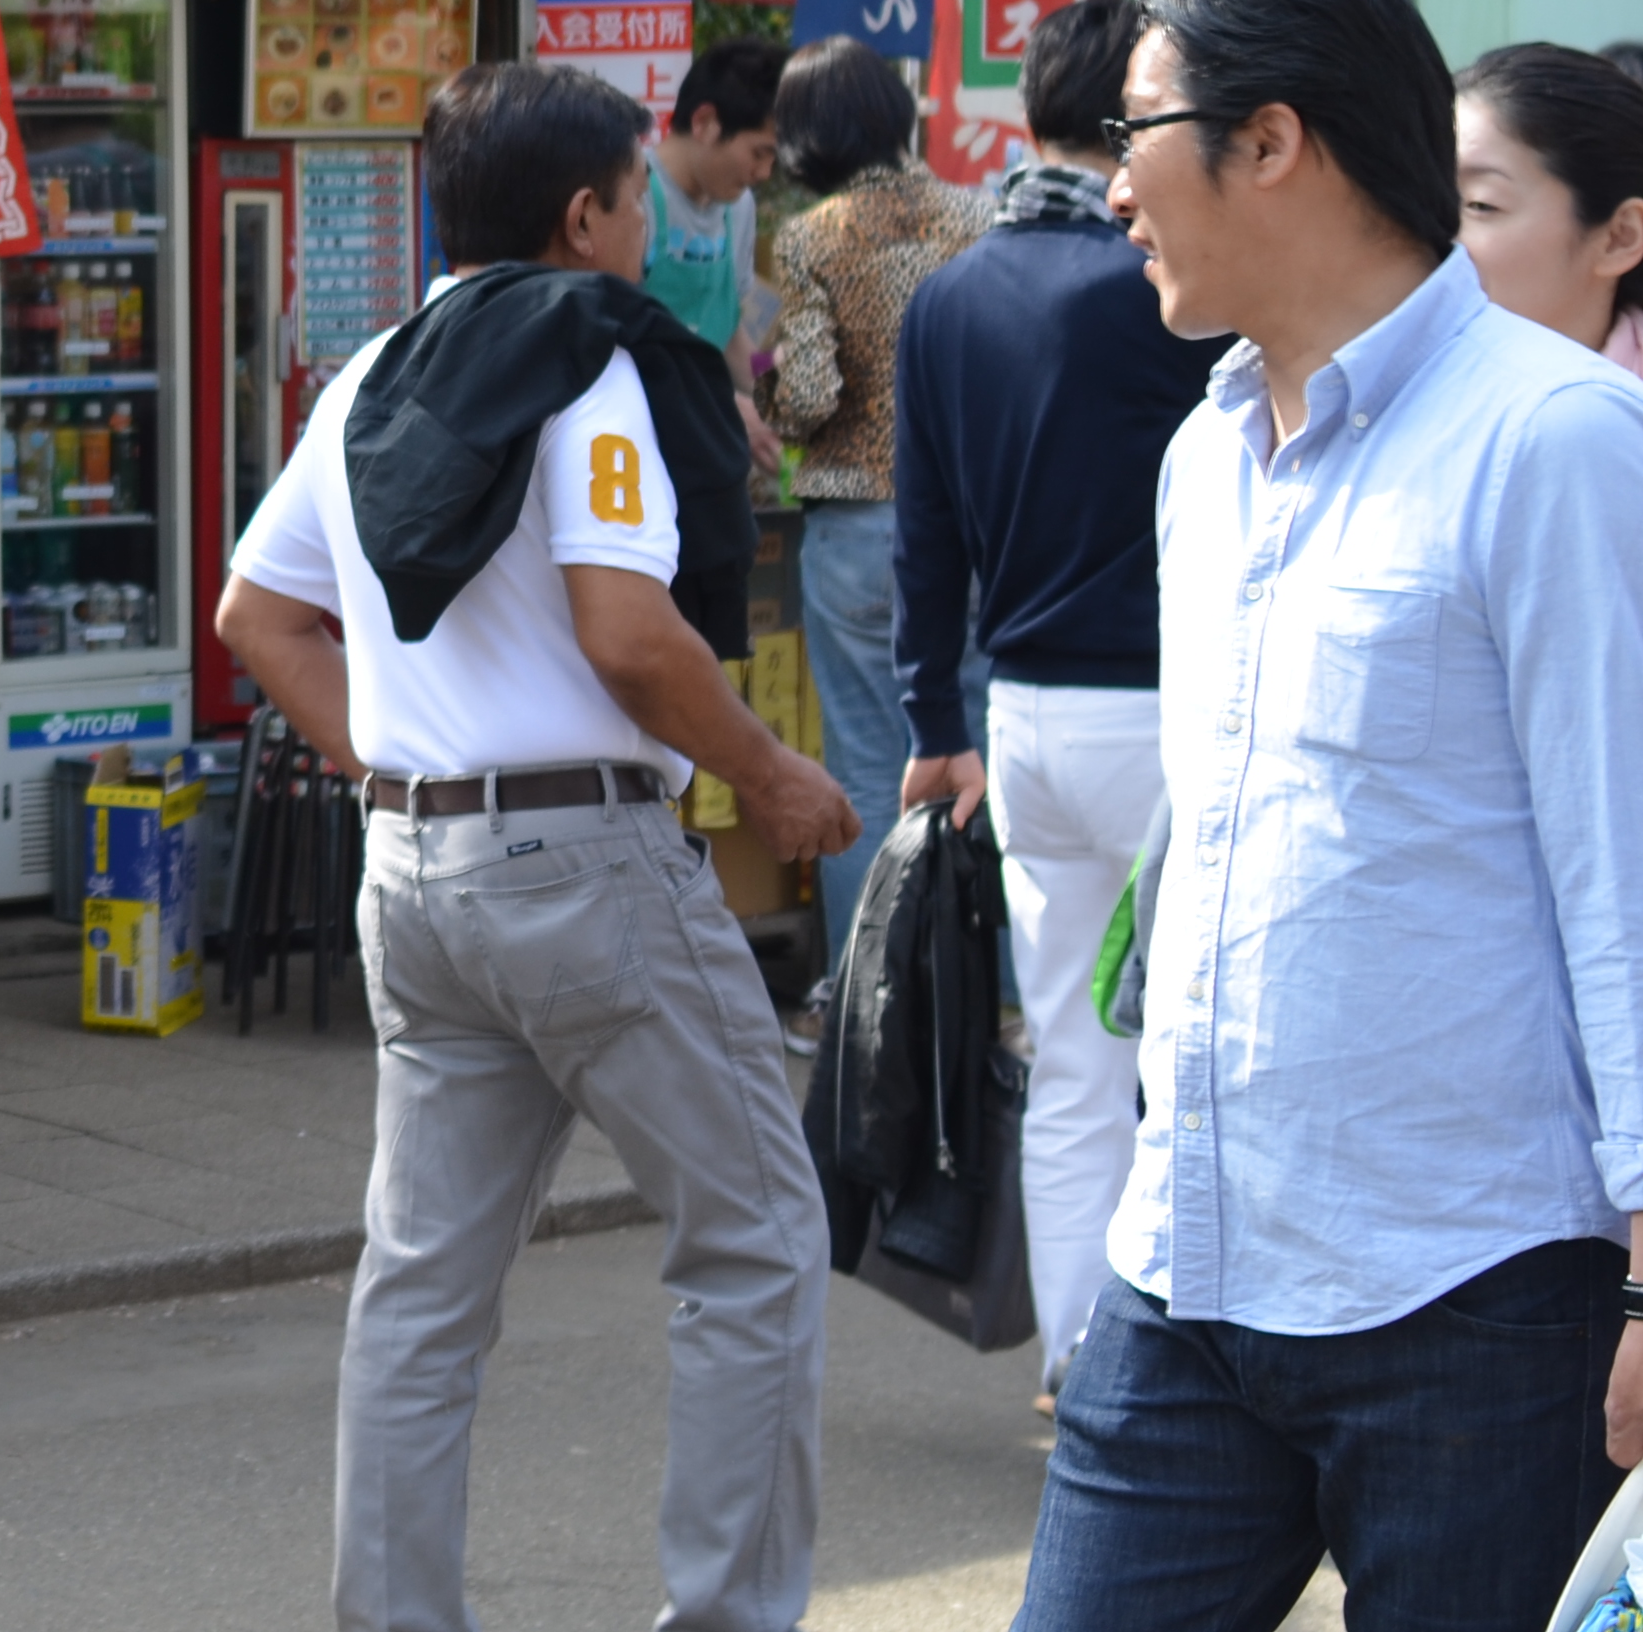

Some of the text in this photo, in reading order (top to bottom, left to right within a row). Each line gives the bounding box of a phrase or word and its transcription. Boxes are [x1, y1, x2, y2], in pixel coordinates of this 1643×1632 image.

[537, 8, 688, 49] 入会受付所
[588, 432, 645, 528] 8
[70, 710, 139, 738] ITO EN
